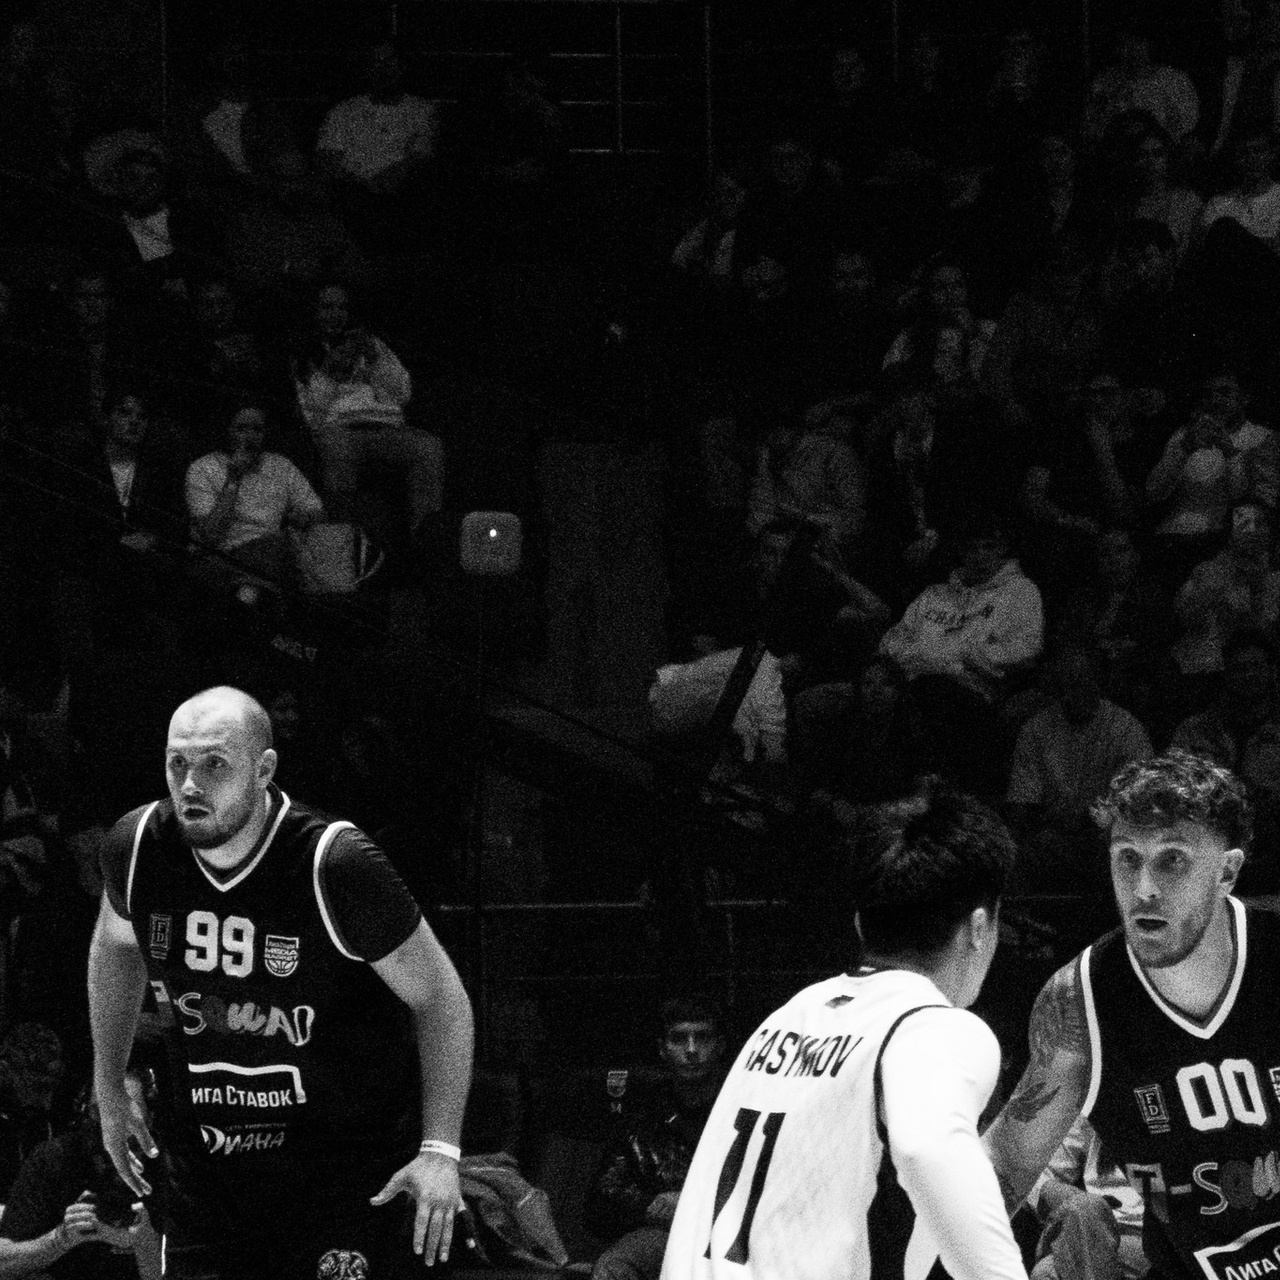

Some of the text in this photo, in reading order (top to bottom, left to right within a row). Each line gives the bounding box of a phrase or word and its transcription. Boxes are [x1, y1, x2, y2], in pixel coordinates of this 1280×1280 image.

[184, 909, 256, 979] 99
[191, 1084, 293, 1108] ИГА СТАВОК
[1175, 1058, 1268, 1132] 00
[703, 1107, 787, 1266] 11
